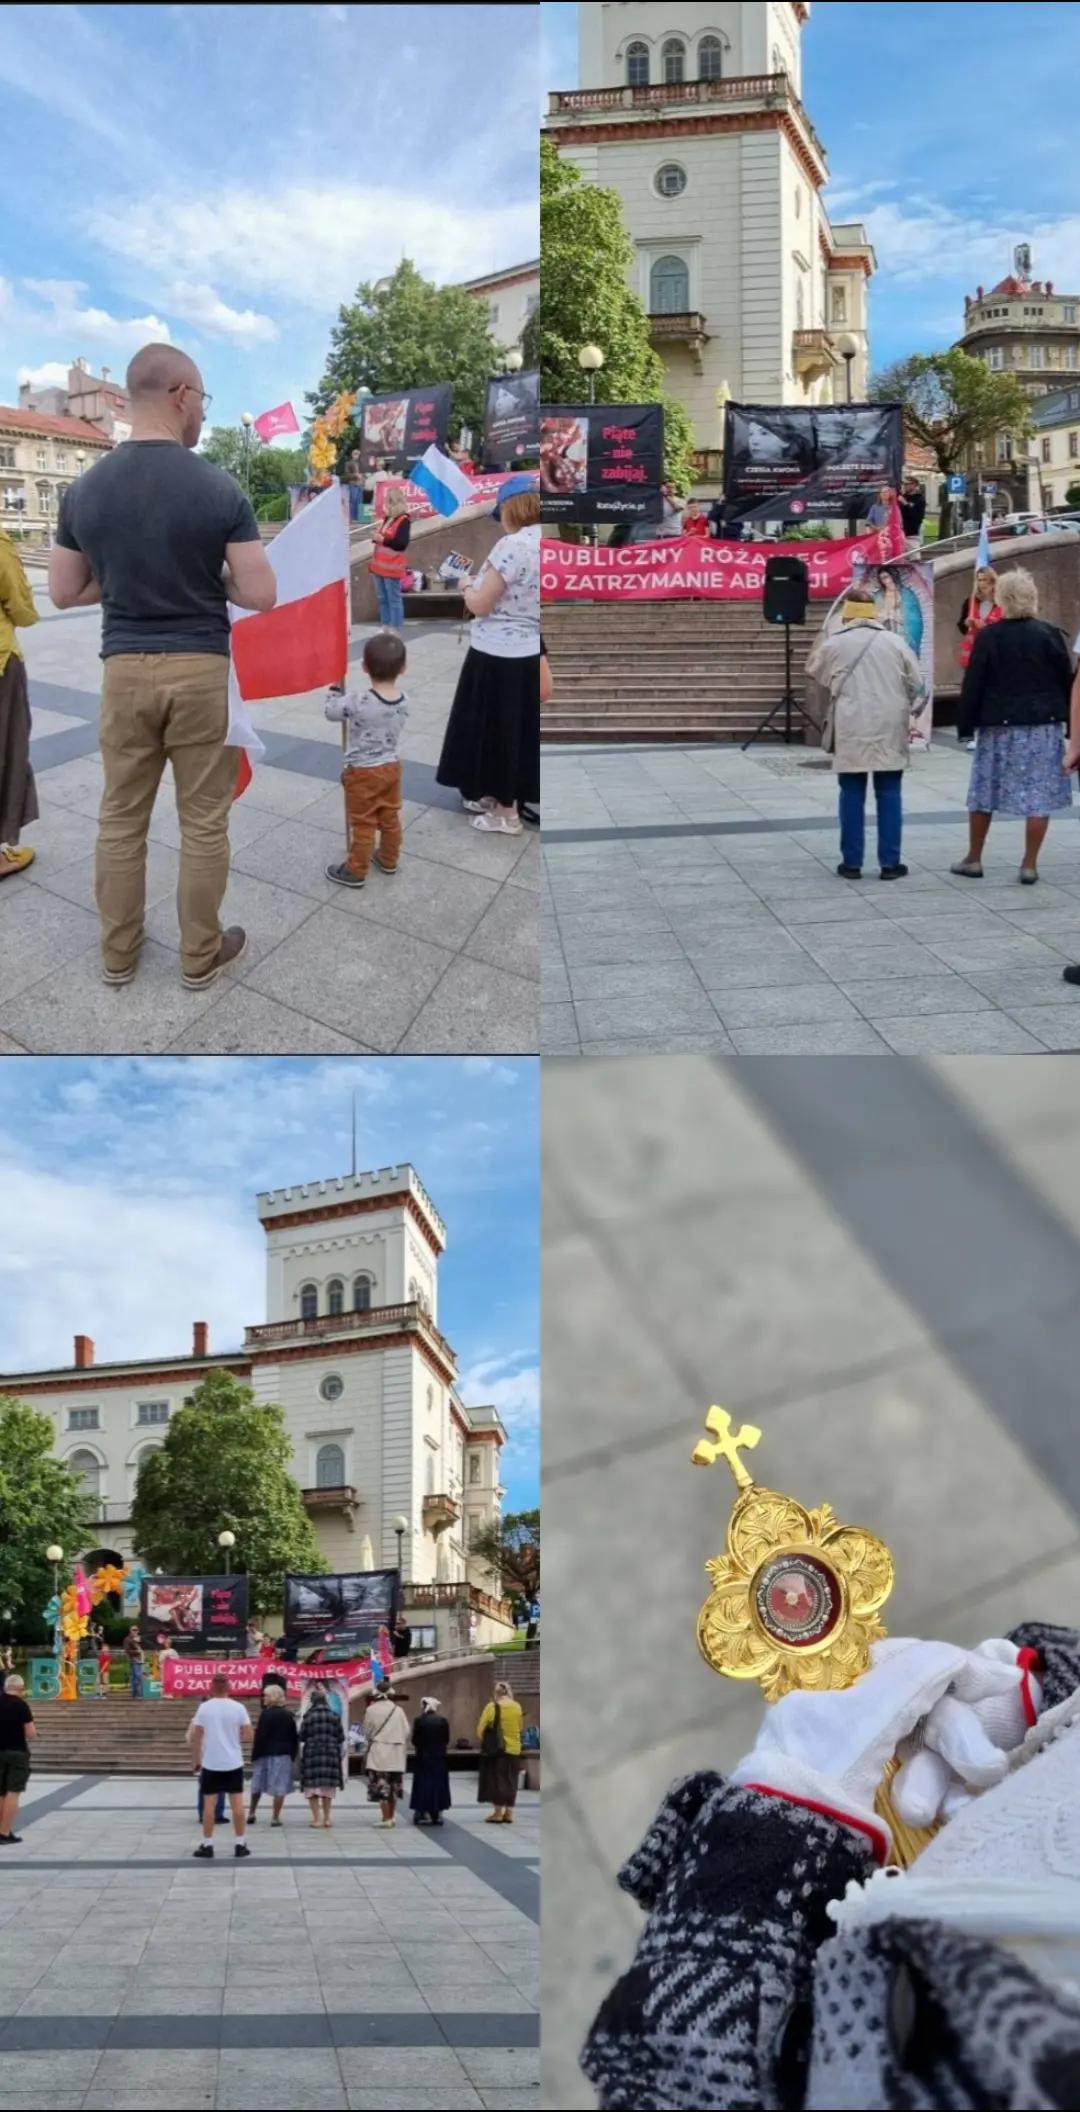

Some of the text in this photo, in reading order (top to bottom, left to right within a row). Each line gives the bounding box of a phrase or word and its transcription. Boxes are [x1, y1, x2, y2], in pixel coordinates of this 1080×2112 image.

[951, 477, 962, 491] P
[542, 546, 828, 567] PUBLICZNY RÓŻAEC
[542, 571, 828, 591] O ZATRZYMANIE ABJI
[173, 1664, 258, 1676] PUBLICZNY
[174, 1680, 185, 1690] O
